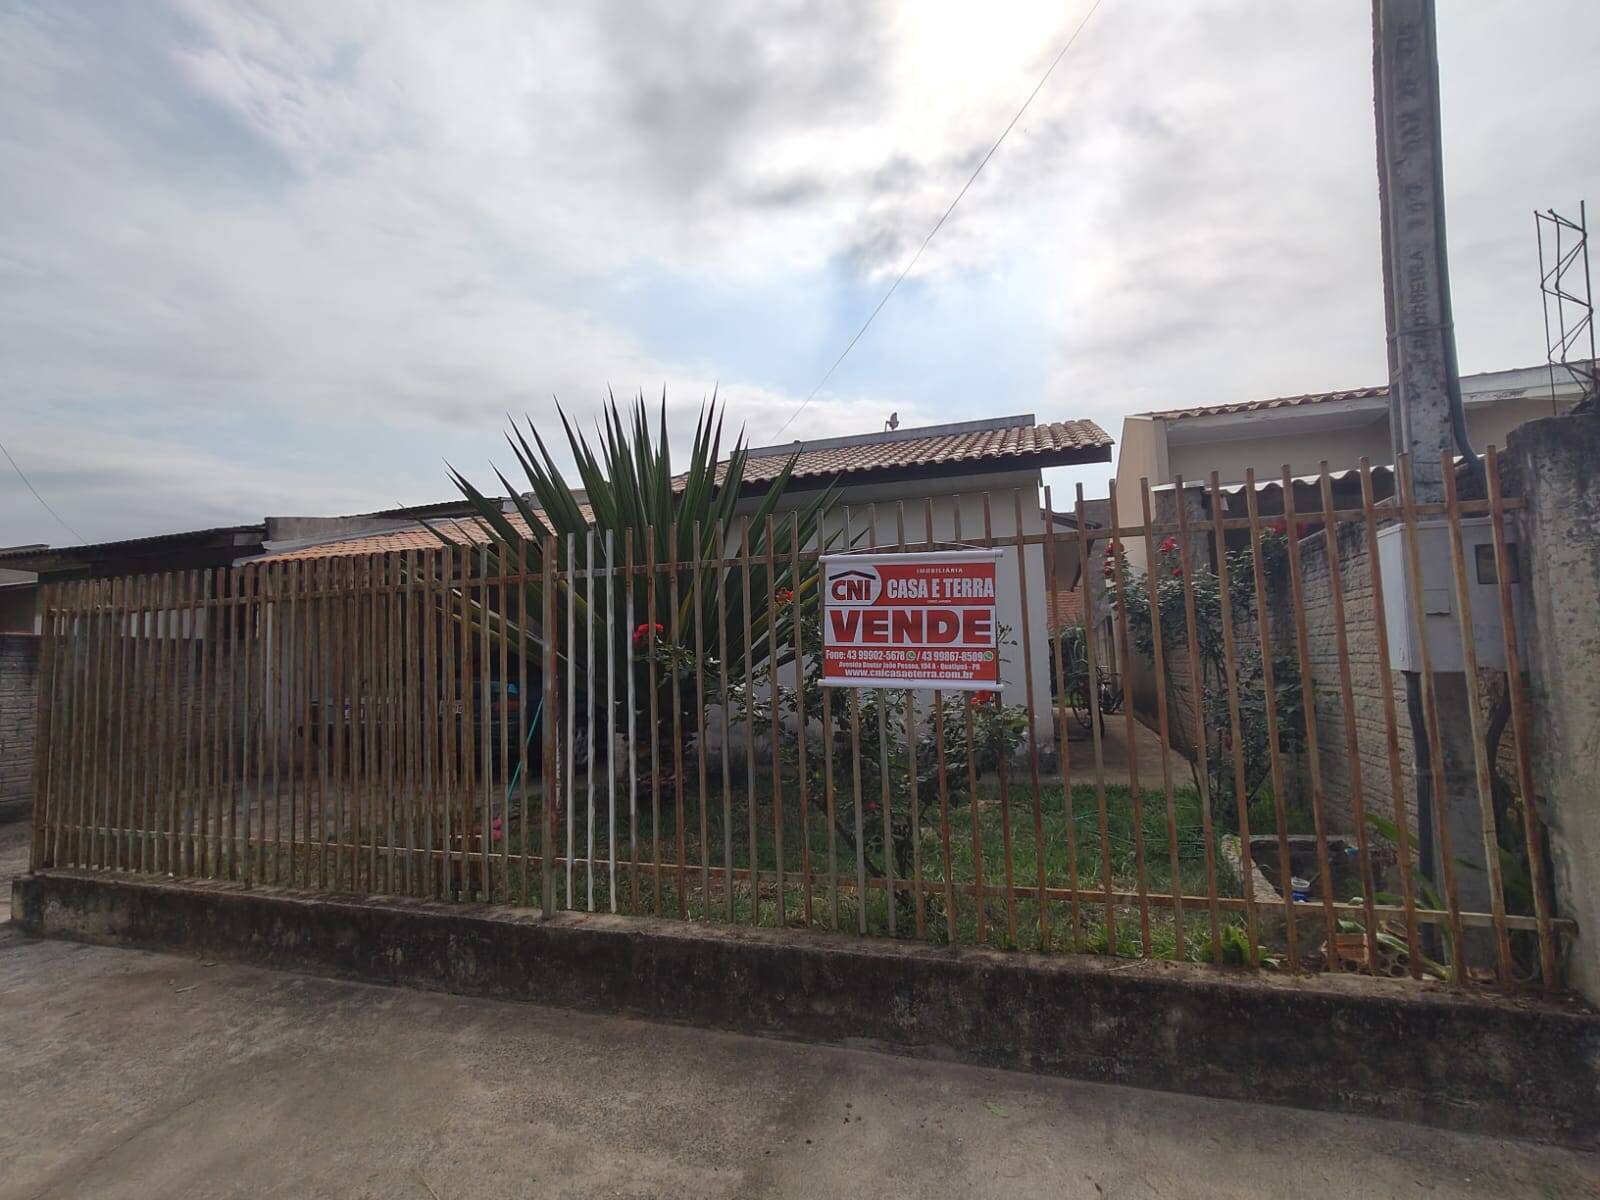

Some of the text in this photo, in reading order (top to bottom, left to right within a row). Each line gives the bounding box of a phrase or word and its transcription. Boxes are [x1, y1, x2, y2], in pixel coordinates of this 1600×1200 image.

[831, 579, 871, 601] CNI
[887, 577, 994, 599] CASA E TERRA
[829, 609, 992, 644] VENDE
[826, 650, 846, 660] Fone:
[847, 650, 857, 660] 43
[858, 650, 905, 661] 99902-5678
[922, 651, 932, 661] 43
